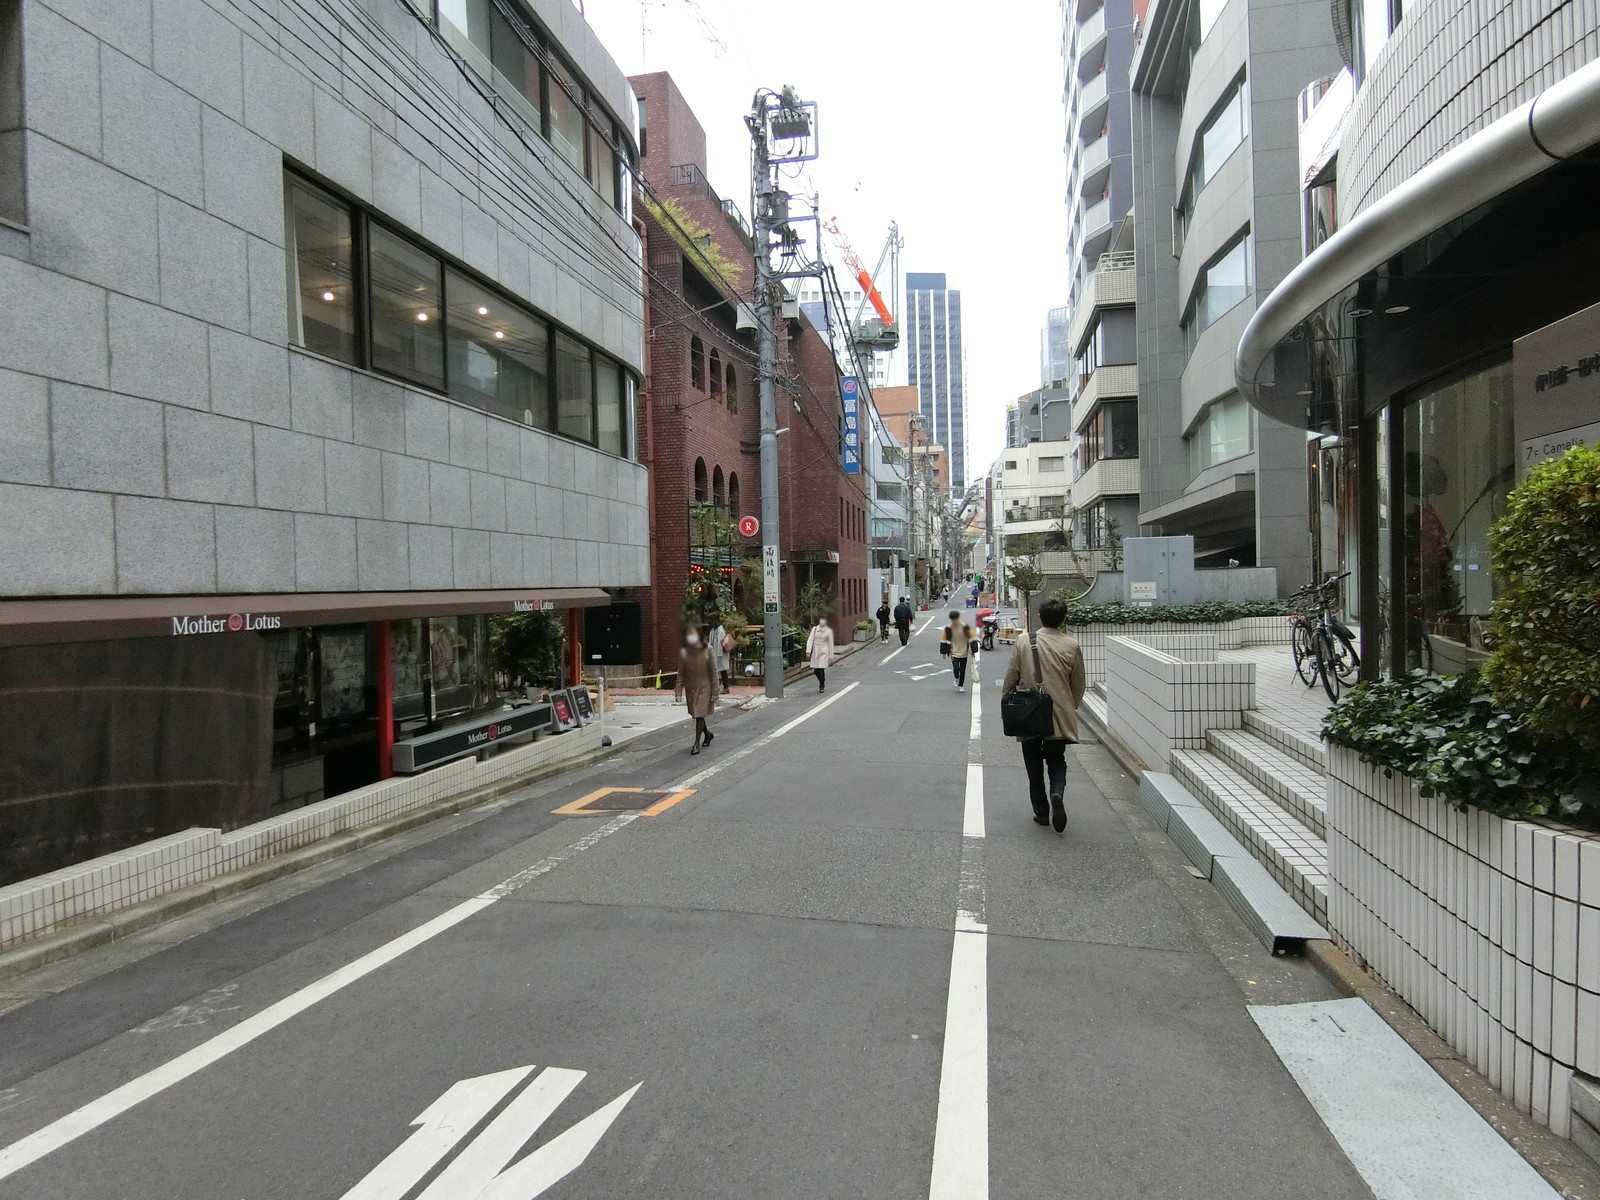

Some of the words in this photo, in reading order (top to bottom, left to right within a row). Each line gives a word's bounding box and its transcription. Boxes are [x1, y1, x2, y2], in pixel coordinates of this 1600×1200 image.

[1543, 438, 1584, 455] Camelia
[746, 521, 752, 531] R
[513, 600, 533, 612] Mother
[539, 599, 554, 610] Lotus
[172, 615, 227, 635] Mother
[245, 613, 281, 631] Lotus
[468, 731, 488, 745] Mother
[497, 724, 512, 735] Lotus
